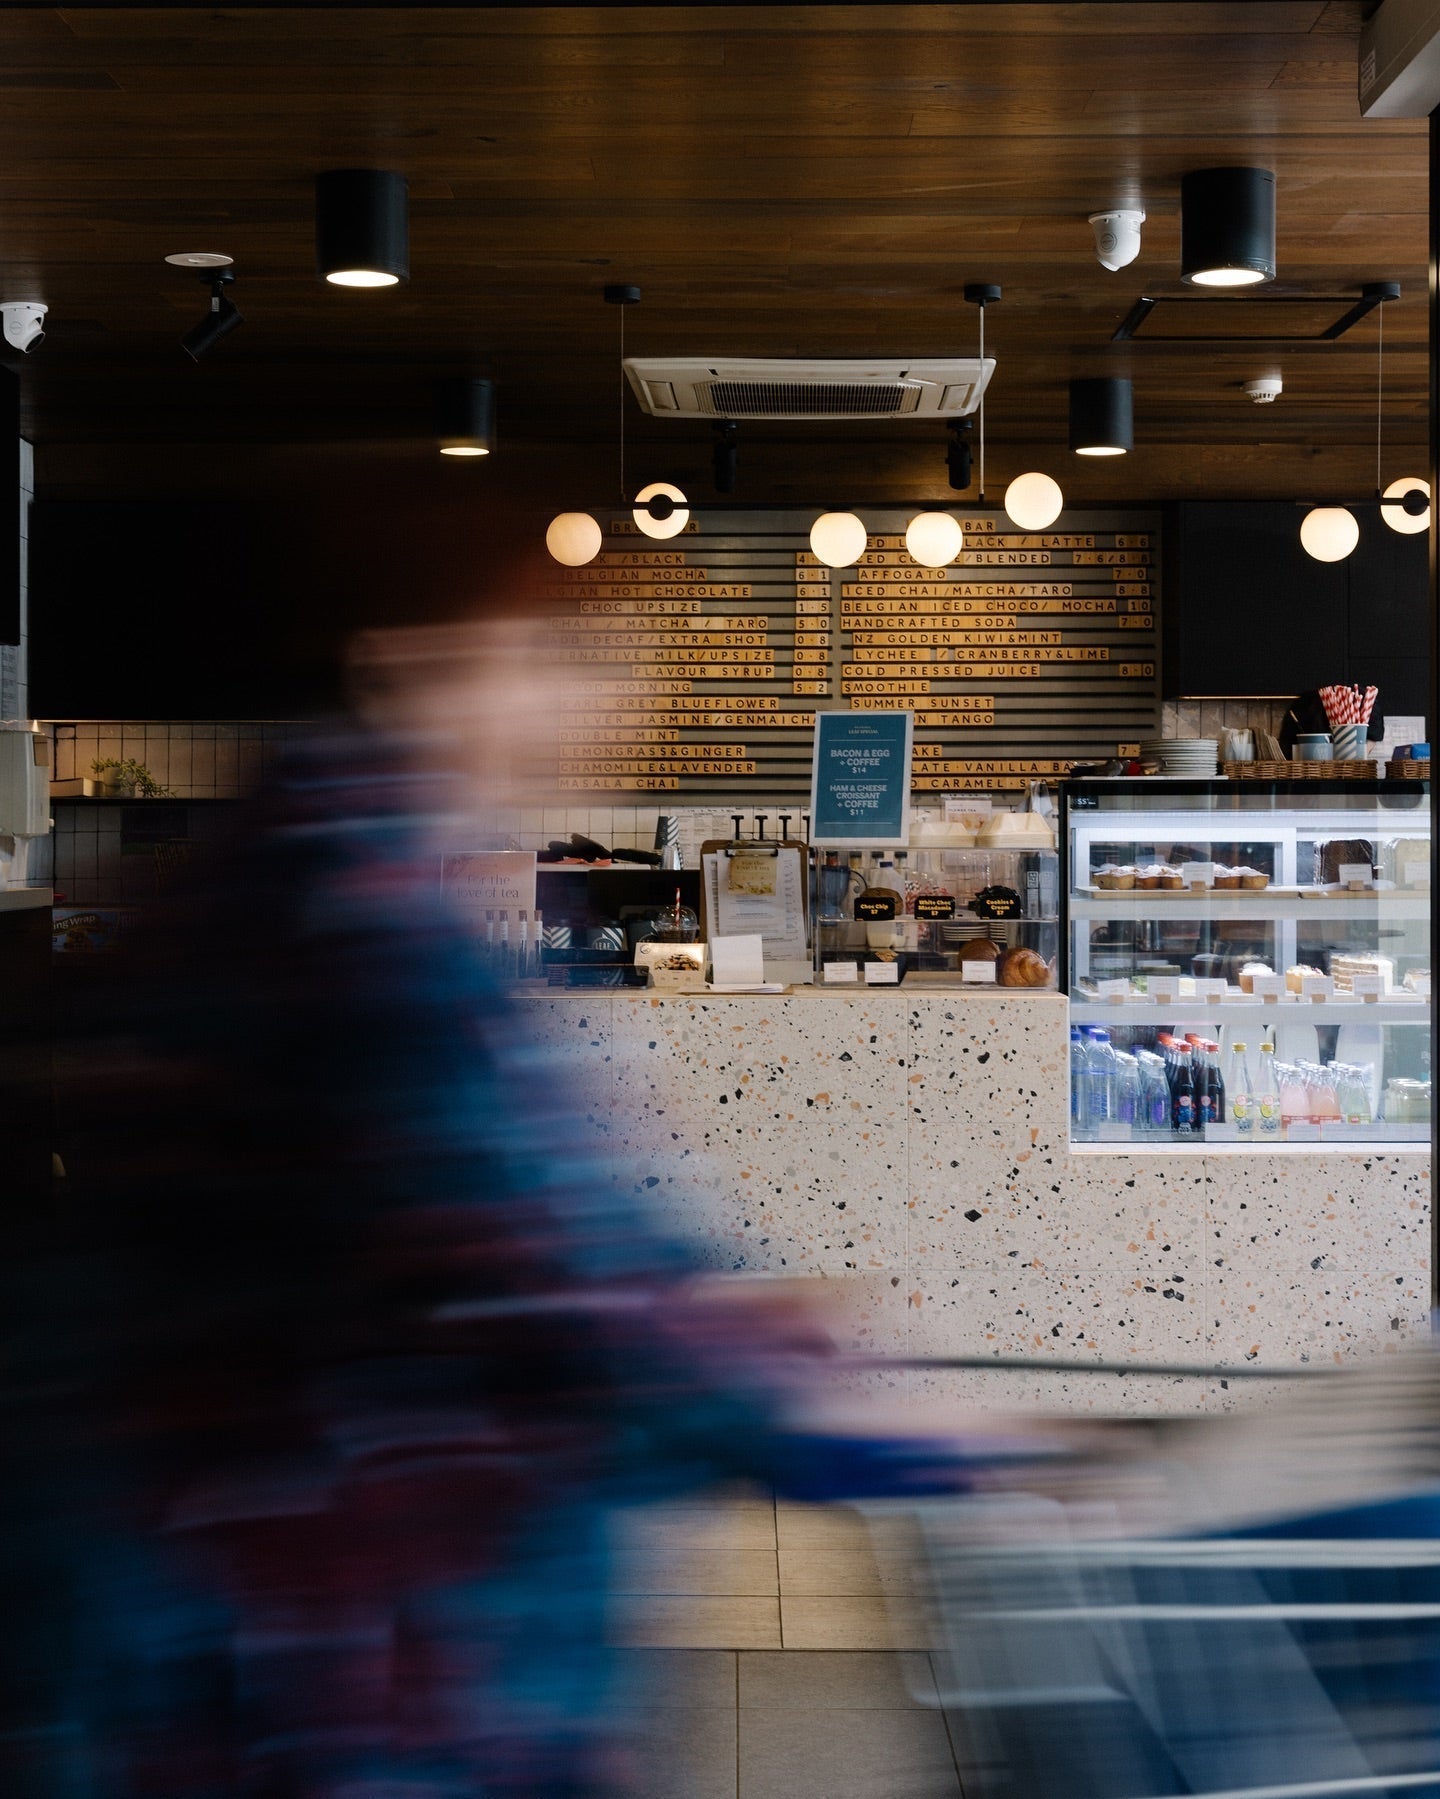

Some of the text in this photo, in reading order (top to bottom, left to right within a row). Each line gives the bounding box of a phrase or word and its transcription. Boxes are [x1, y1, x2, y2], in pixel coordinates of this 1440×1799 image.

[965, 521, 993, 531] BAR
[867, 539, 885, 548] ED
[965, 538, 1005, 547] LACK
[1041, 537, 1093, 547] LATTE
[567, 571, 639, 580] BELGIAN
[652, 571, 705, 580] MOCHA
[860, 571, 946, 580] AFFOGATO
[611, 587, 641, 596] HOT
[655, 587, 748, 596] CHOCOLATE
[846, 586, 885, 595] ICED
[581, 603, 622, 612] CHOC
[636, 603, 698, 612] UPSIZE
[844, 602, 918, 611] BELGIAN
[933, 602, 973, 611] ICED
[1062, 601, 1115, 611] MOCHA
[1131, 601, 1149, 611] 10
[552, 619, 589, 628] CHAI
[626, 619, 690, 628] MATCHA
[727, 619, 767, 628] TARO
[843, 618, 960, 627] HANDCRAFTED
[975, 618, 1015, 627] SODA
[725, 635, 765, 644] SHOT
[854, 633, 1060, 643] NZ GOLDEN KIWI&MINT
[856, 650, 917, 659] LYCHEE
[957, 649, 1107, 659] CRANBERRY&LIME
[634, 667, 707, 676] FLAVOUR
[722, 667, 773, 676] SYRUP
[844, 666, 885, 675] COLD
[900, 666, 973, 676] PRESSED
[988, 666, 1038, 675] JUICE
[616, 683, 690, 692] MORNING
[845, 683, 928, 692] SMOOTHIE
[616, 699, 656, 708] GREY
[671, 699, 777, 708] BLUEFLOWER
[853, 698, 992, 708] SUMMER SUNSET
[562, 715, 623, 724] SILVER
[942, 714, 993, 724] TANGO
[560, 731, 678, 740] DOUBLE MINT
[562, 747, 743, 756] LEMONGRASS&GINGER
[830, 749, 863, 758] BACON
[871, 749, 890, 757] EGG
[846, 758, 880, 766] COFFEE
[561, 763, 753, 772] CHAMOMILE&LAVENDER
[560, 779, 676, 788] MASALA CHAI
[835, 792, 881, 800] CROISSANT
[844, 800, 879, 808] COFFEE
[490, 874, 511, 885] the
[501, 889, 520, 898] tea
[53, 915, 96, 930] ing Wrap
